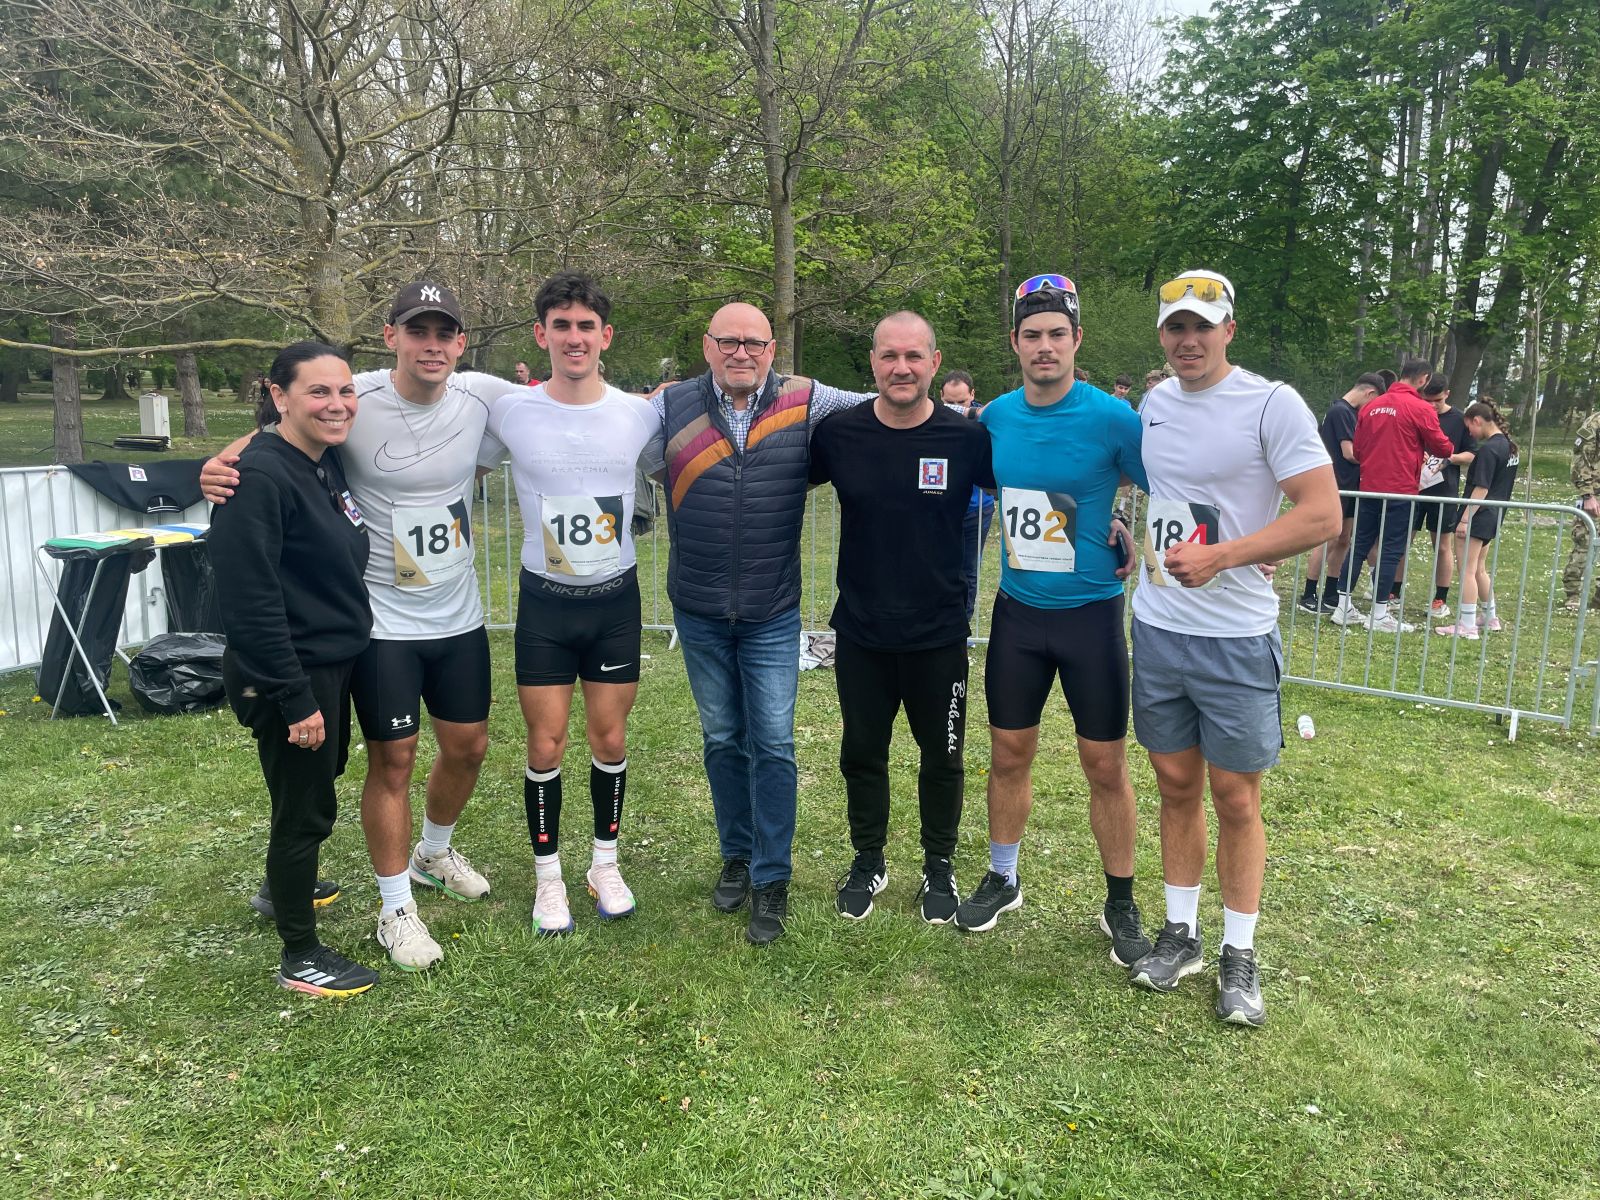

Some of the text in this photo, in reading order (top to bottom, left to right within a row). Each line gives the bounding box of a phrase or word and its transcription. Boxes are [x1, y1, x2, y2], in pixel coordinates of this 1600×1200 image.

[1369, 407, 1397, 417] СРБИЈА
[408, 517, 461, 557] 181
[550, 513, 616, 546] 183
[1006, 506, 1067, 543] 182
[541, 577, 624, 596] NIKE PRO
